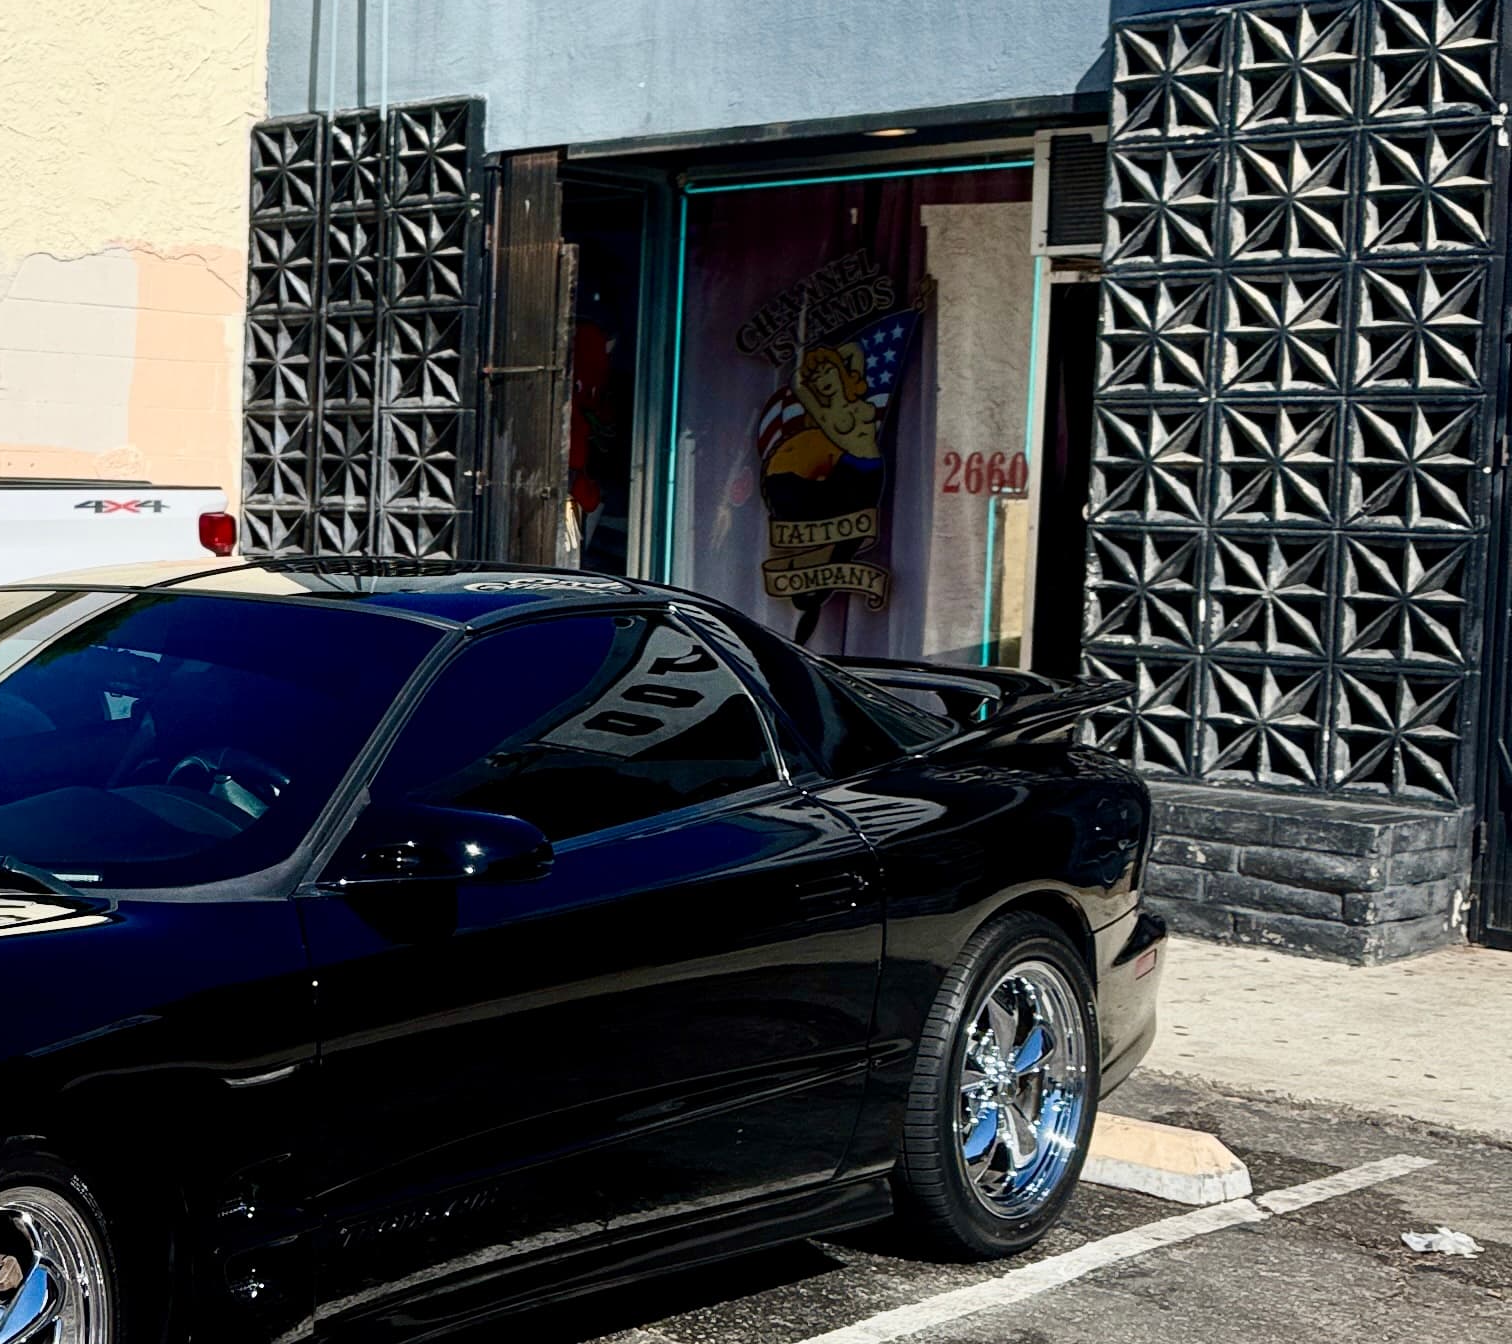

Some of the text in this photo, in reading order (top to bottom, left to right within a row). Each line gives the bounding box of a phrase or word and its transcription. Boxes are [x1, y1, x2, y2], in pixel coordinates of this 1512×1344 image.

[736, 248, 881, 353] CHANNEL
[943, 452, 1029, 494] 2660
[776, 513, 873, 544] TATTOO
[773, 568, 882, 592] COMPANY
